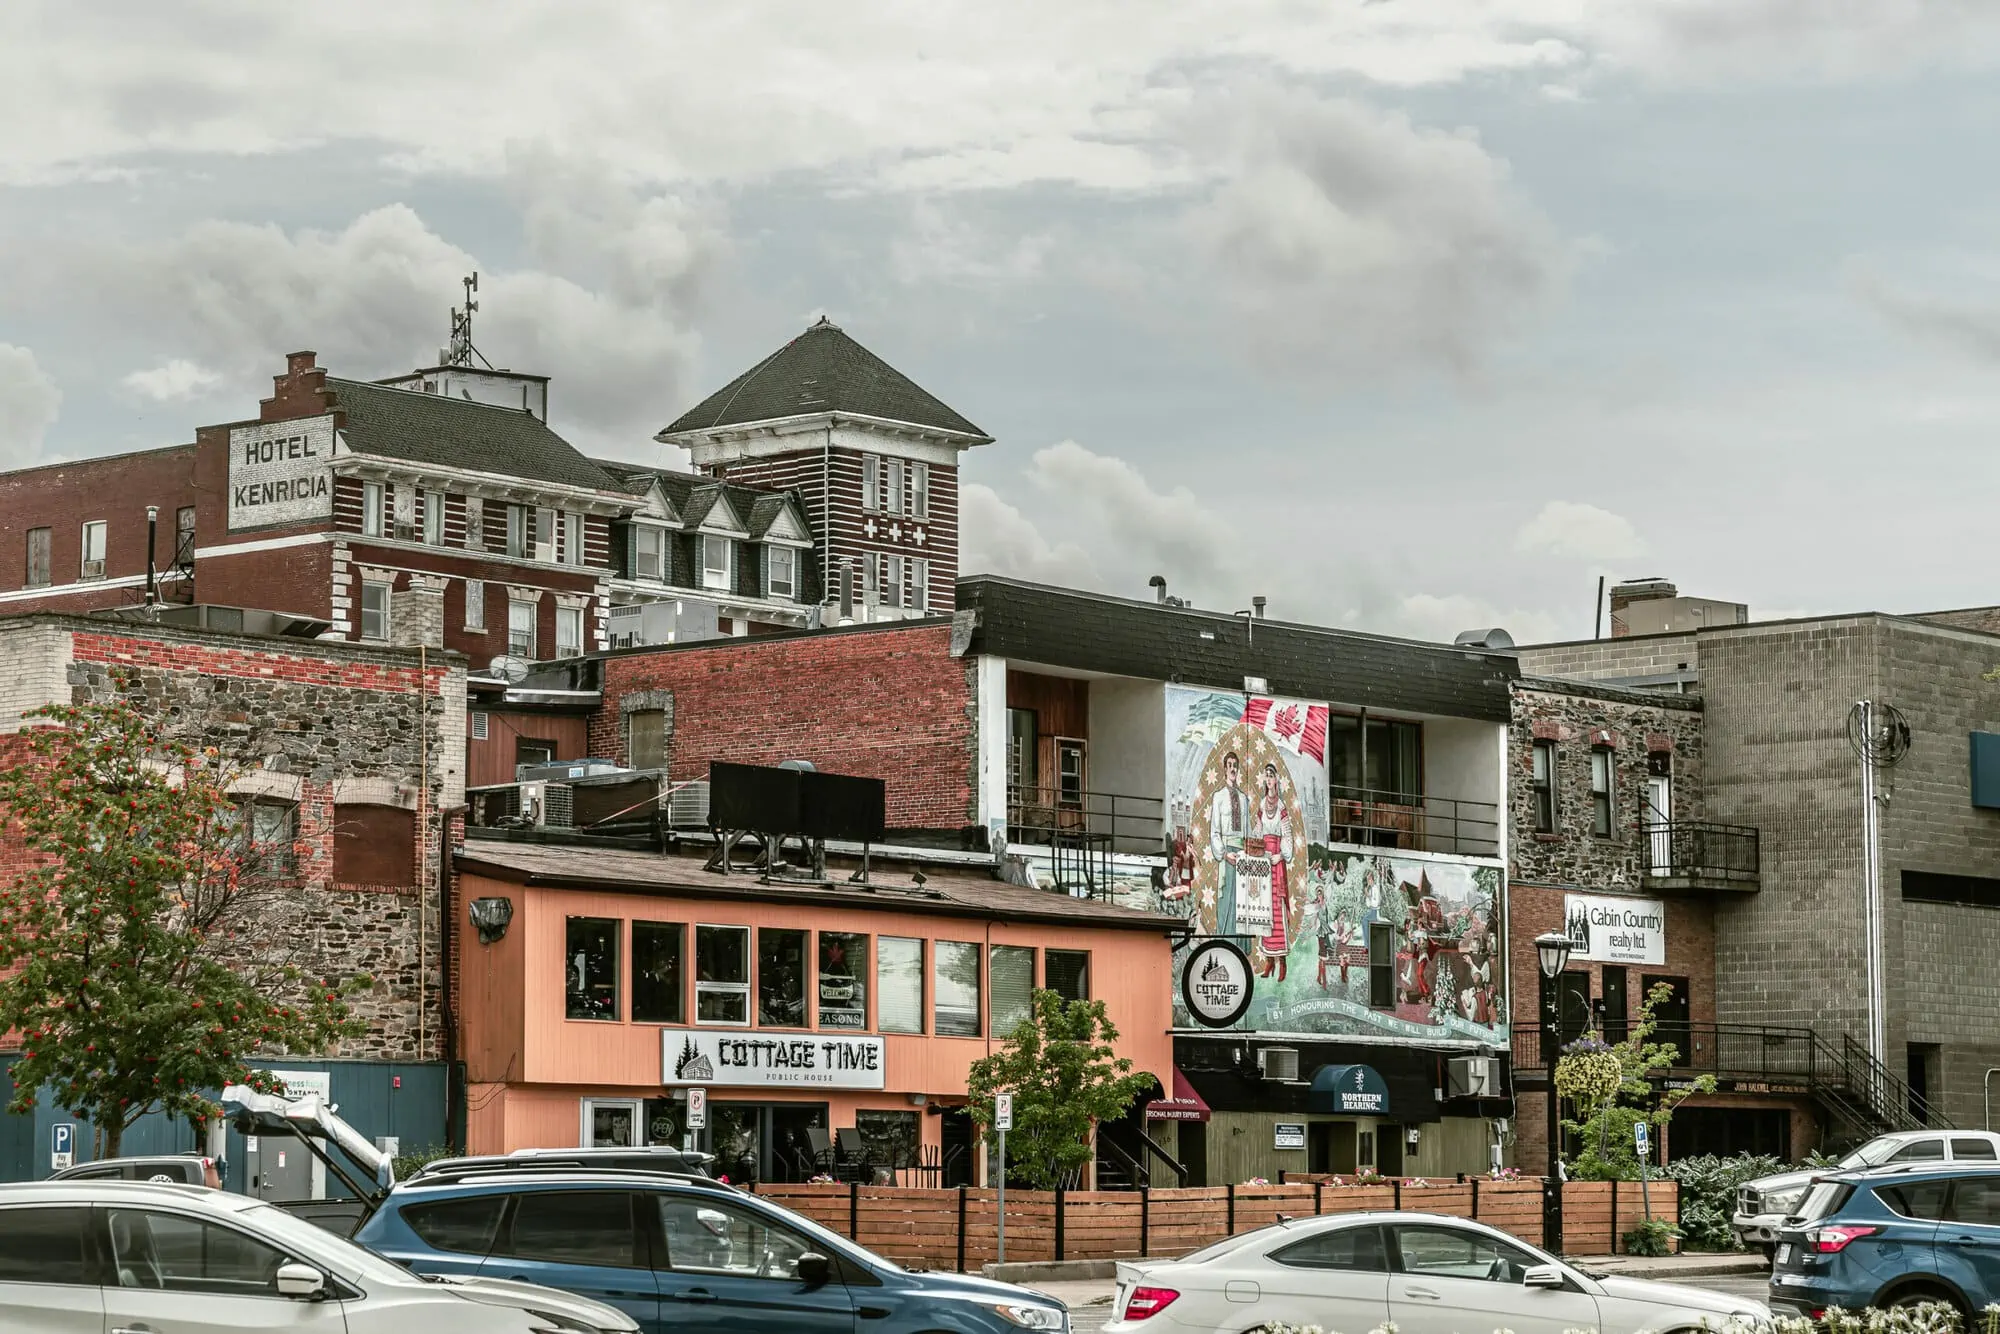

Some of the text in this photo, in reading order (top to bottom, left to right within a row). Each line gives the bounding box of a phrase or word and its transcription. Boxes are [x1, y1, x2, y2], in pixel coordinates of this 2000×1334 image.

[246, 435, 316, 465] HOTEL
[234, 475, 328, 508] KENRICIA
[1590, 906, 1662, 934] Cabin Country
[1609, 931, 1633, 951] realty
[1196, 984, 1239, 995] COTTAGE
[1204, 996, 1231, 1006] TIME
[819, 1013, 860, 1025] EASONS
[1272, 1010, 1283, 1020] BY
[1291, 1001, 1335, 1016] HONOURING
[1342, 1003, 1357, 1014] THE
[1363, 1010, 1381, 1023] PAST
[1388, 1019, 1399, 1029] WE
[1405, 1023, 1421, 1035] WILL
[1427, 1027, 1447, 1036] BUILD
[1451, 1020, 1465, 1030] OUR
[718, 1038, 878, 1071] COTTAGE TIME
[766, 1073, 833, 1082] PUBLIC HOUSE
[1341, 1092, 1382, 1102] NORTHERN
[1343, 1101, 1376, 1111] HEARING
[1146, 1110, 1167, 1118] ERSONAL
[56, 1126, 69, 1151] P
[1637, 1125, 1644, 1140] P
